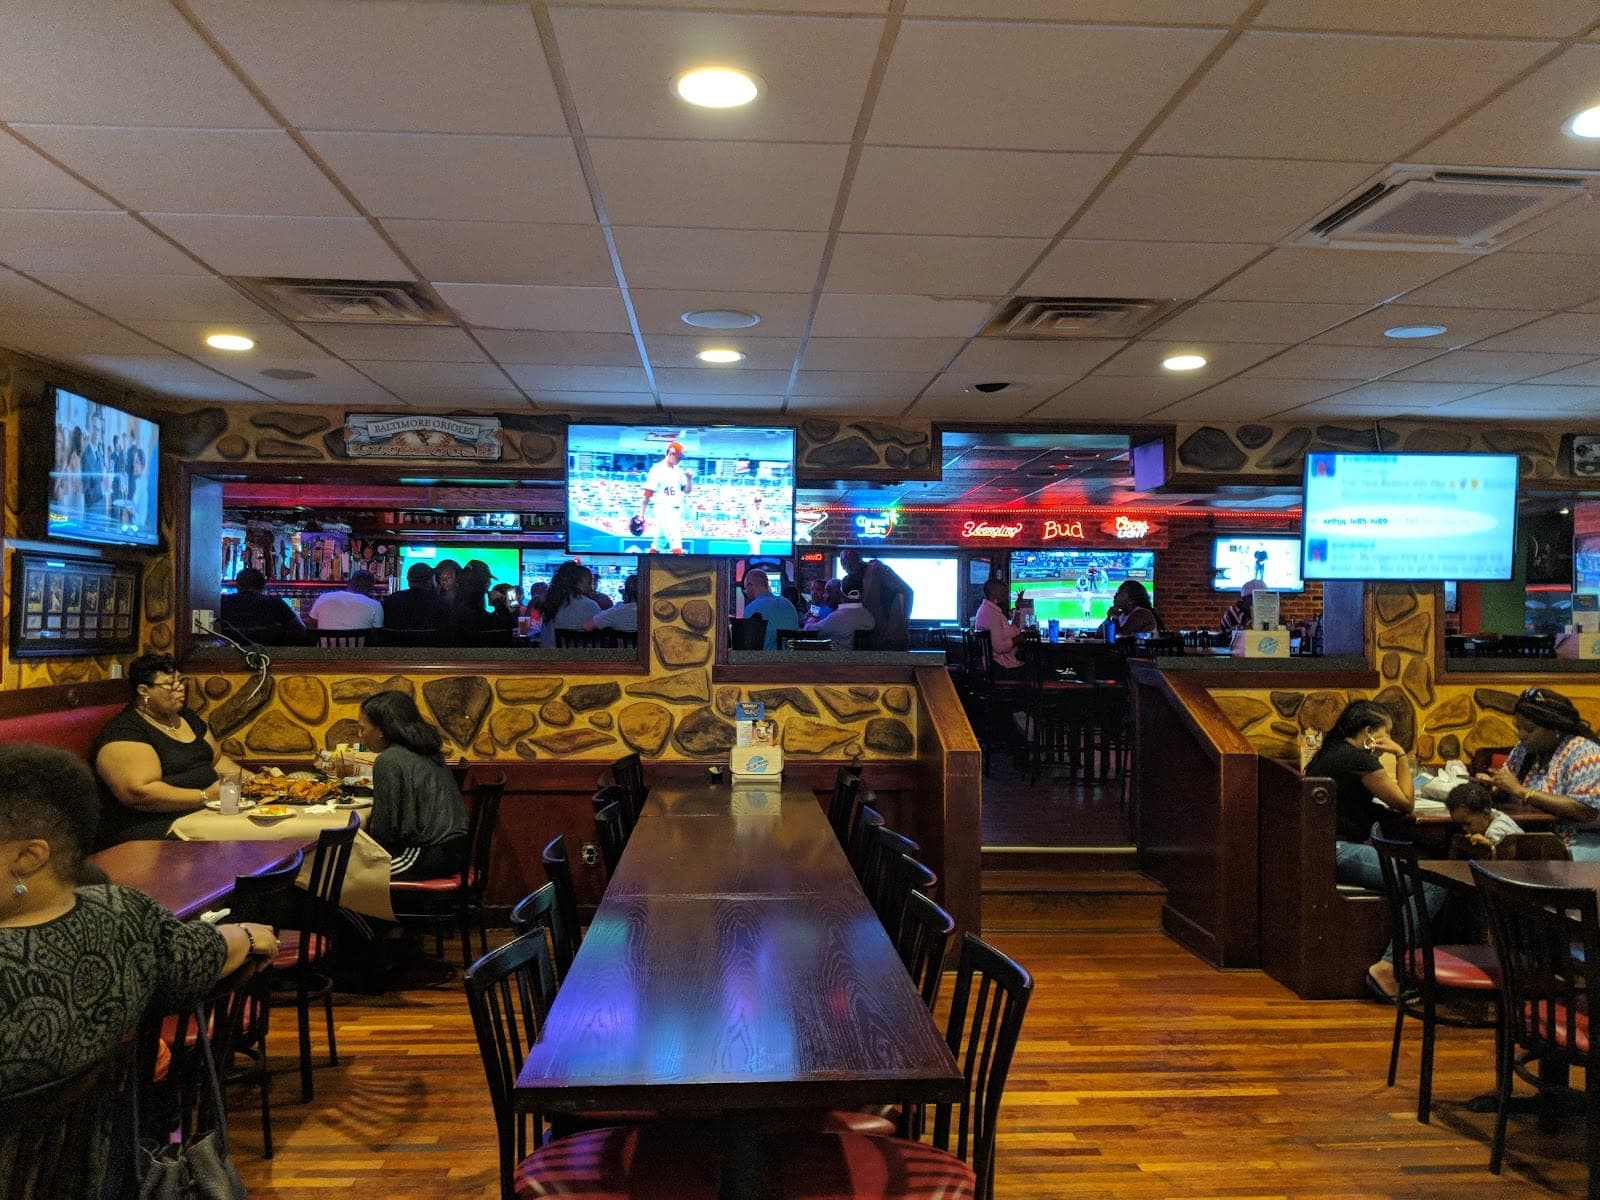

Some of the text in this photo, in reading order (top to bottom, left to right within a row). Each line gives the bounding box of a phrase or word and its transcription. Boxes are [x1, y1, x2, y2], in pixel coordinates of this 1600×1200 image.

[374, 419, 475, 436] BALTIMORE ORIOLES
[1042, 520, 1085, 540] Bud
